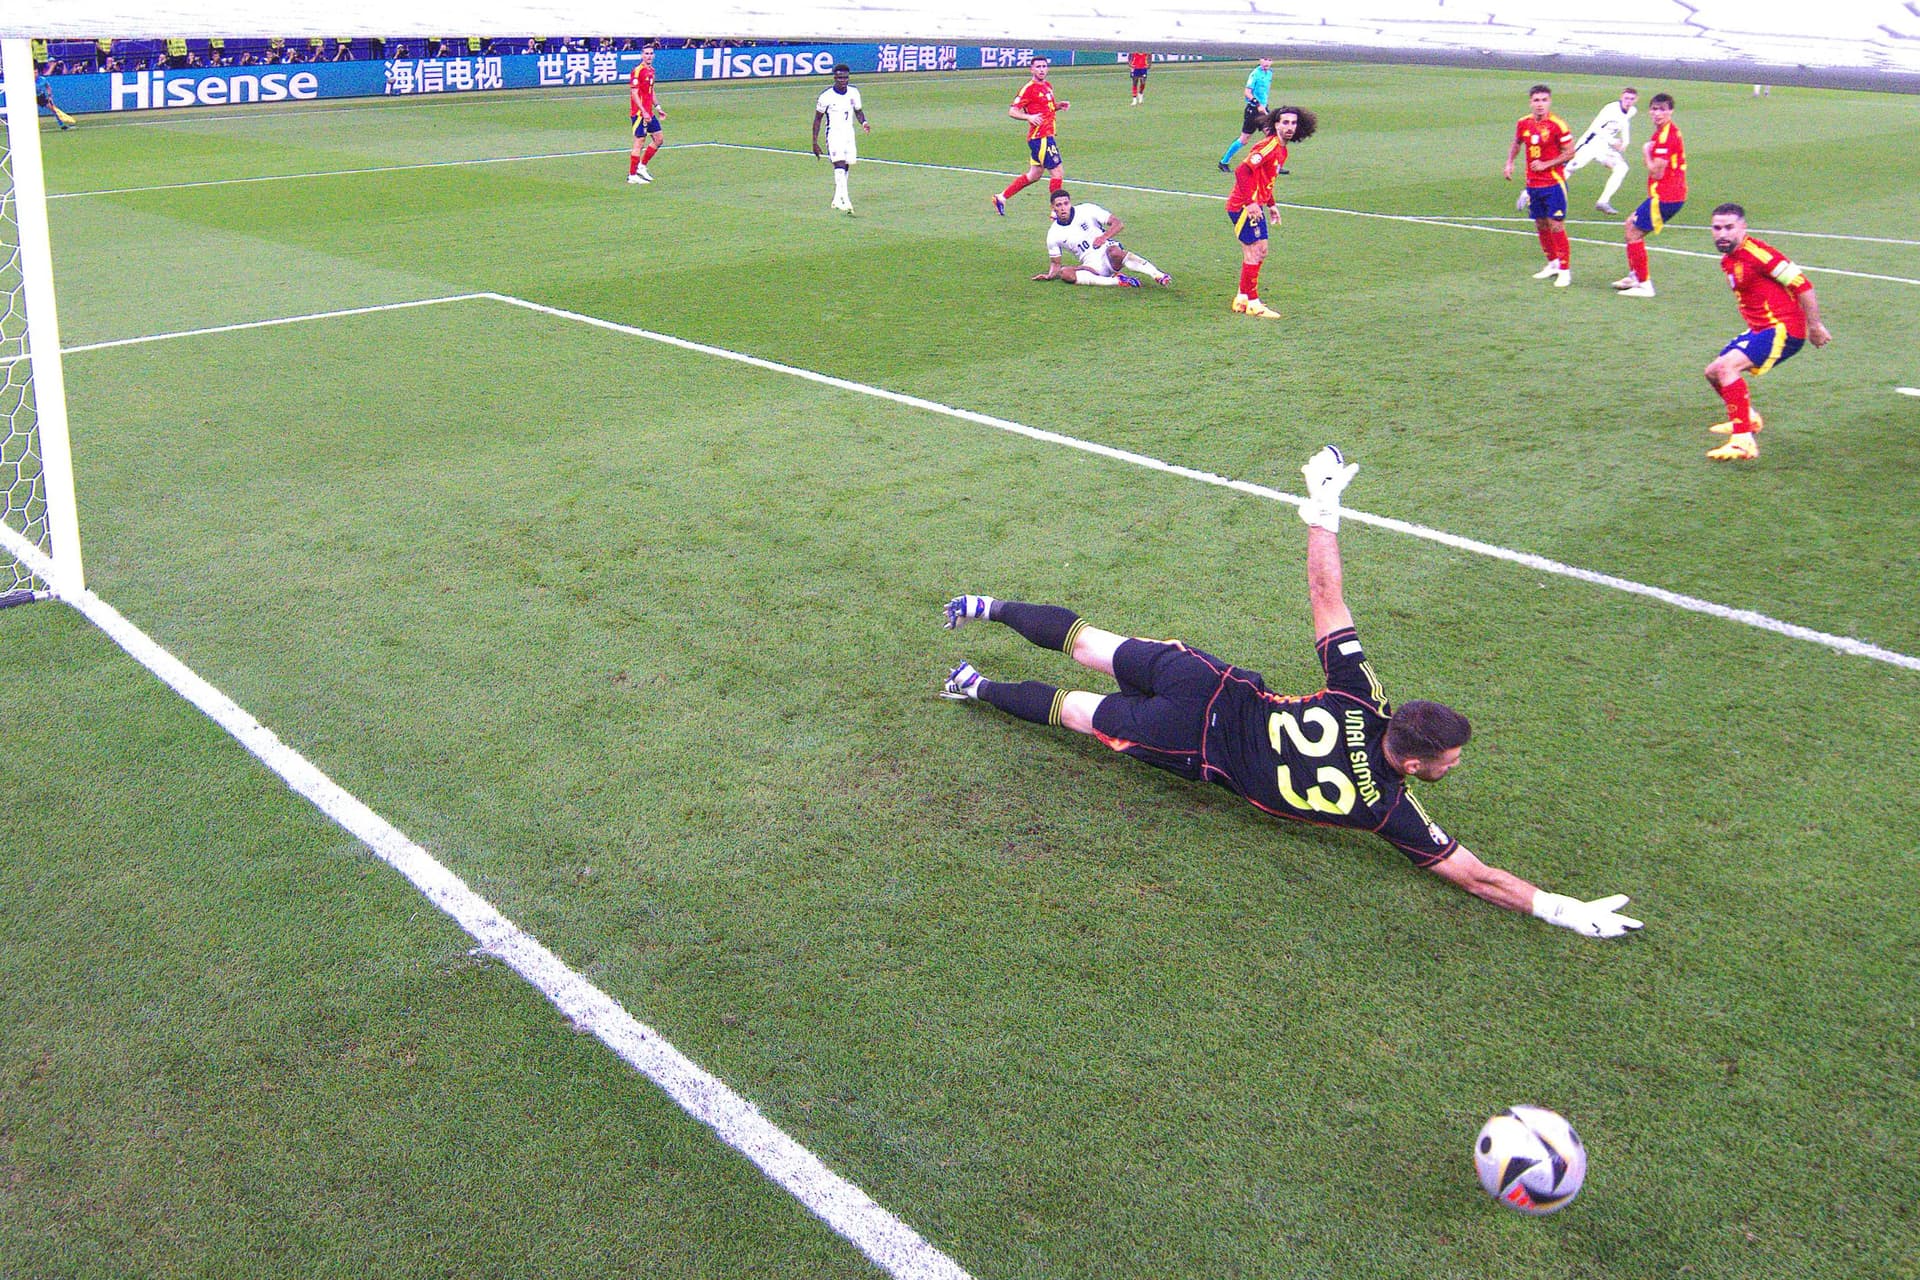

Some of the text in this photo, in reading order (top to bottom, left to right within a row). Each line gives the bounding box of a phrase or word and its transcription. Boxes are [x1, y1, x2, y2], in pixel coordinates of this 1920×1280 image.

[695, 48, 834, 79] Hisense
[877, 44, 957, 71] 海信电视
[111, 70, 318, 110] Hisense
[384, 57, 503, 94] 海信电视
[844, 111, 849, 121] 7
[1077, 240, 1090, 252] 10
[1268, 706, 1356, 815] 23
